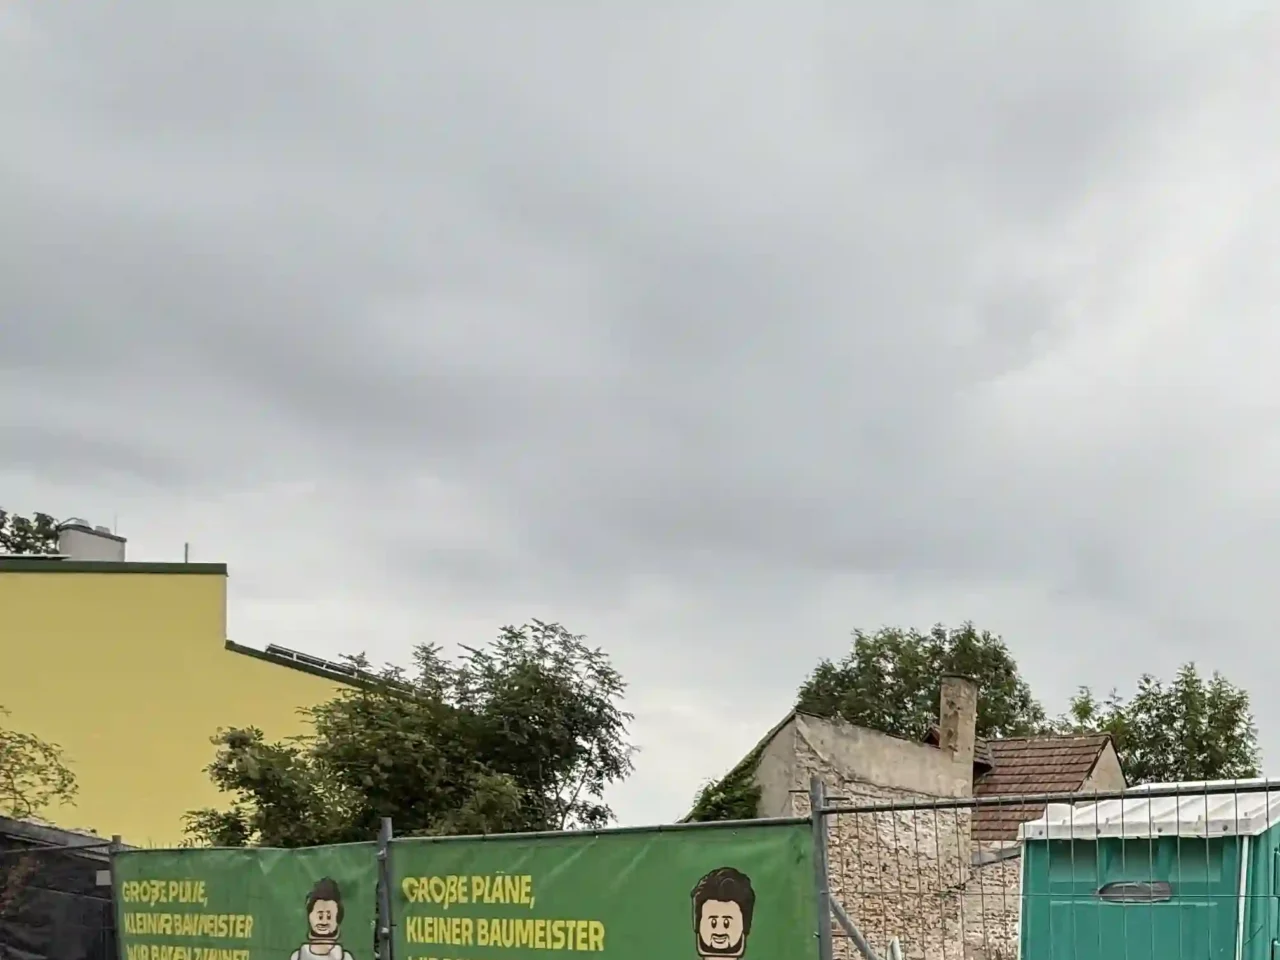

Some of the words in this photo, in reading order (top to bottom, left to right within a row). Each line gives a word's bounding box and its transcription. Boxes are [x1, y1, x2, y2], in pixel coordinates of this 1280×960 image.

[471, 871, 535, 909] PLÄNE,
[406, 916, 473, 946] KLEINER
[477, 918, 605, 951] BAUMEISTER
